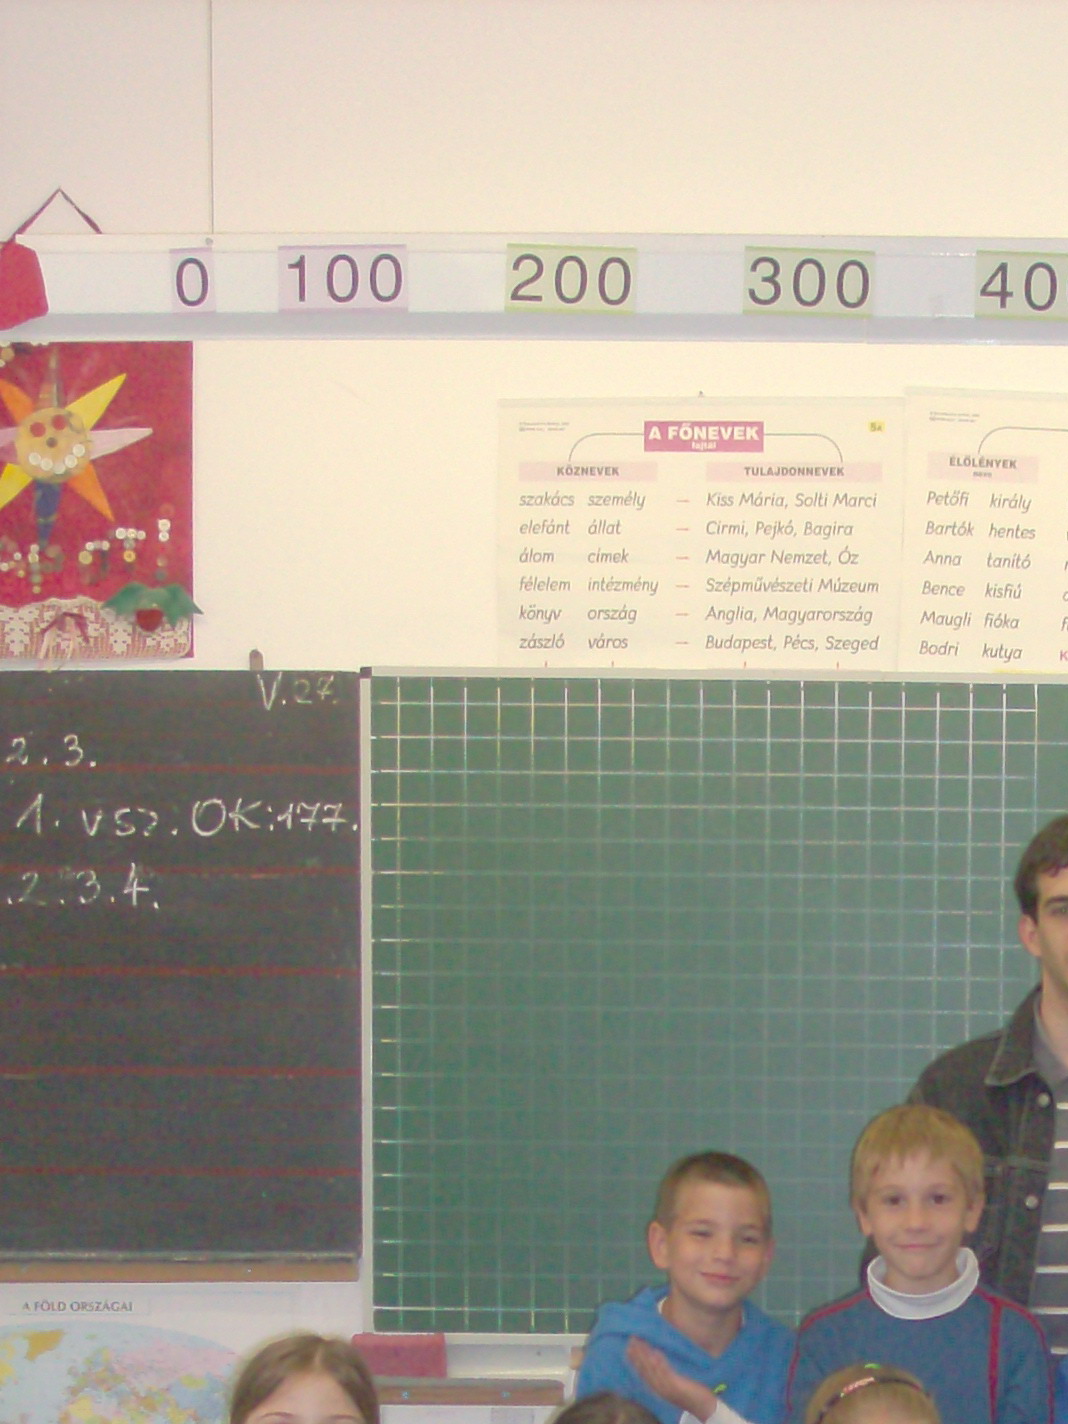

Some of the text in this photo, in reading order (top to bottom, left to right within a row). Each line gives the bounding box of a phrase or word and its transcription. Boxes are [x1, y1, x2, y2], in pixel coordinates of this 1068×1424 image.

[176, 258, 208, 306] 0
[288, 254, 402, 302] 100
[511, 254, 631, 305] 200
[749, 257, 869, 308] 300
[649, 423, 759, 440] A FŐNEVEK
[557, 465, 619, 476] KÖZNEVEK
[744, 467, 844, 476] TULAJDONNEVEK
[950, 456, 1016, 469] ÉLŐLÉNYEK
[519, 490, 645, 510] szakács személy
[706, 492, 877, 509] Kiss Mária, Solti Marci
[927, 490, 1031, 514] Petőfi király
[520, 519, 620, 535] elefánt állat
[706, 520, 853, 540] Cirmi, Pejkó, Bagira
[925, 521, 1035, 539] Bartók hentes
[519, 547, 554, 563] álom
[706, 545, 859, 568] Magyar Nemzet, Óz
[923, 550, 1031, 569] Anna tanító
[520, 576, 658, 596] félelem intézmény
[706, 577, 879, 596] Szépművészeti Múzeum
[922, 581, 1021, 599] Bence kisfiú
[519, 604, 637, 624] könyv ország
[705, 606, 873, 626] Anglia, Magyarország
[920, 611, 1019, 630] Maugli fióka
[519, 633, 628, 649] zászló város
[706, 634, 879, 654] Budapest, Pécs, Szeged
[919, 640, 1022, 663] Bodri kutya
[22, 1300, 132, 1312] A FÖLD ORSZÁGAI
